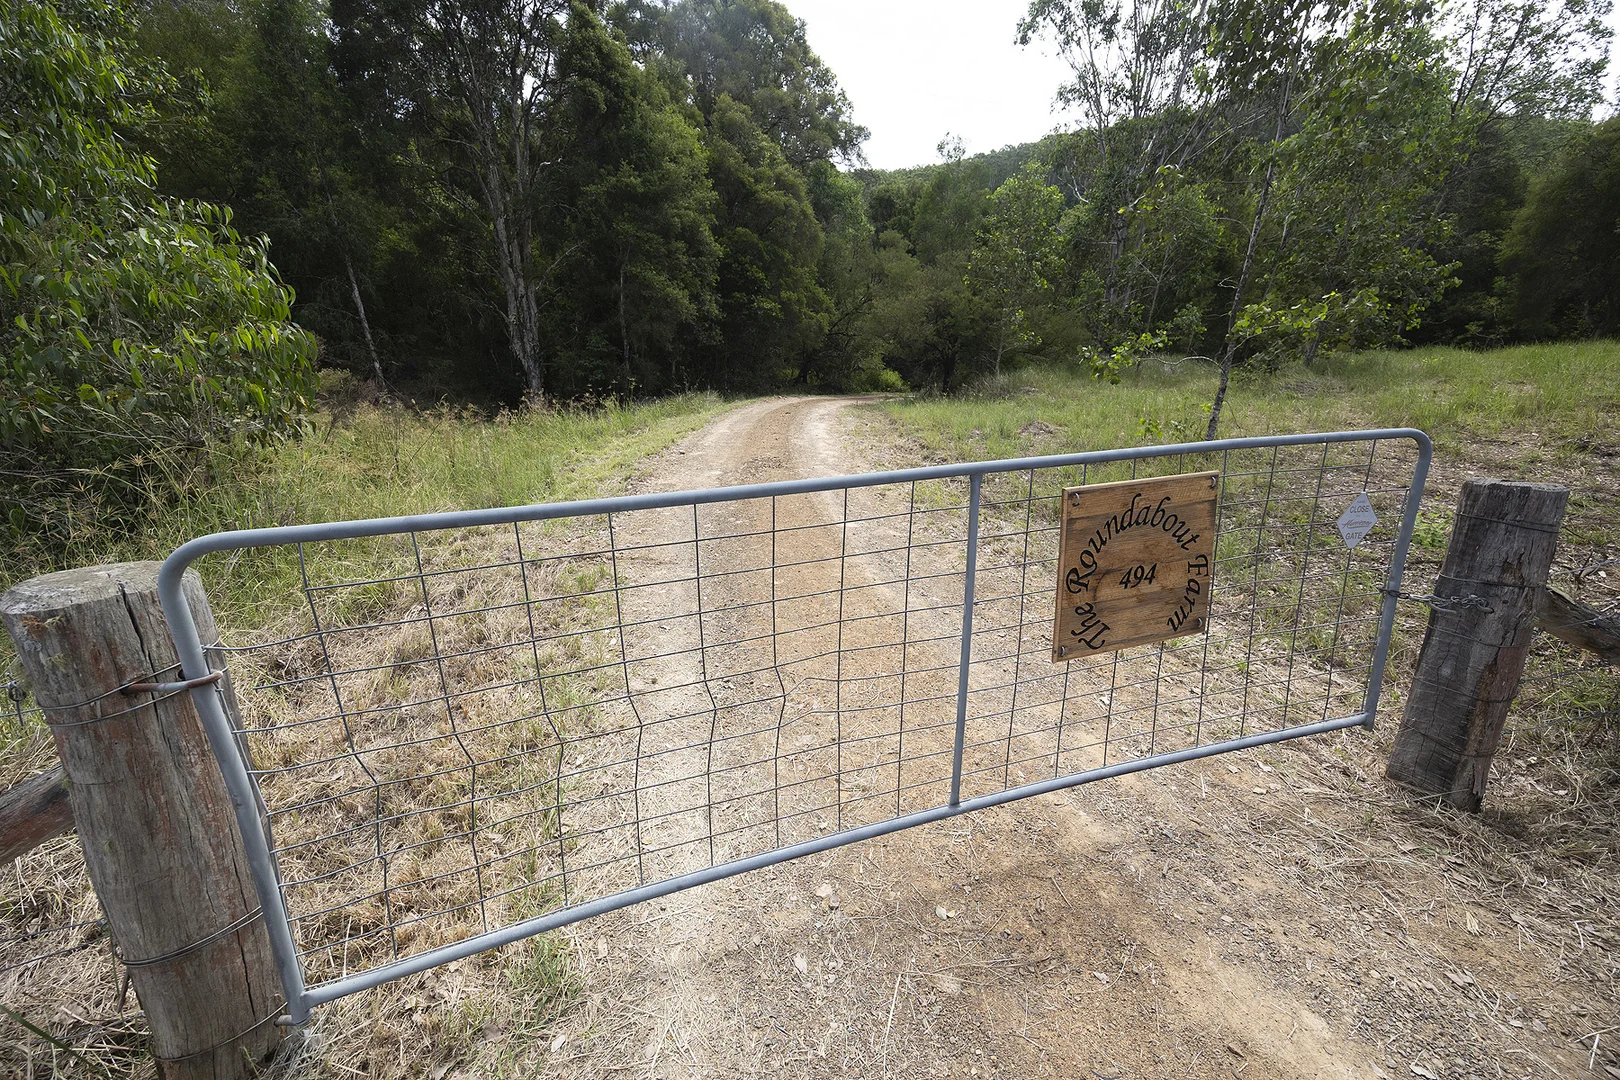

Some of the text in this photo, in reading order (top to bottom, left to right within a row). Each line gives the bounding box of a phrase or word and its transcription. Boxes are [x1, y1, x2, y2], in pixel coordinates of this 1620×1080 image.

[1350, 505, 1370, 514] CLOSE
[1345, 531, 1363, 541] GATE
[1066, 493, 1209, 650] The Roundabout Farm
[1119, 563, 1158, 590] 494
